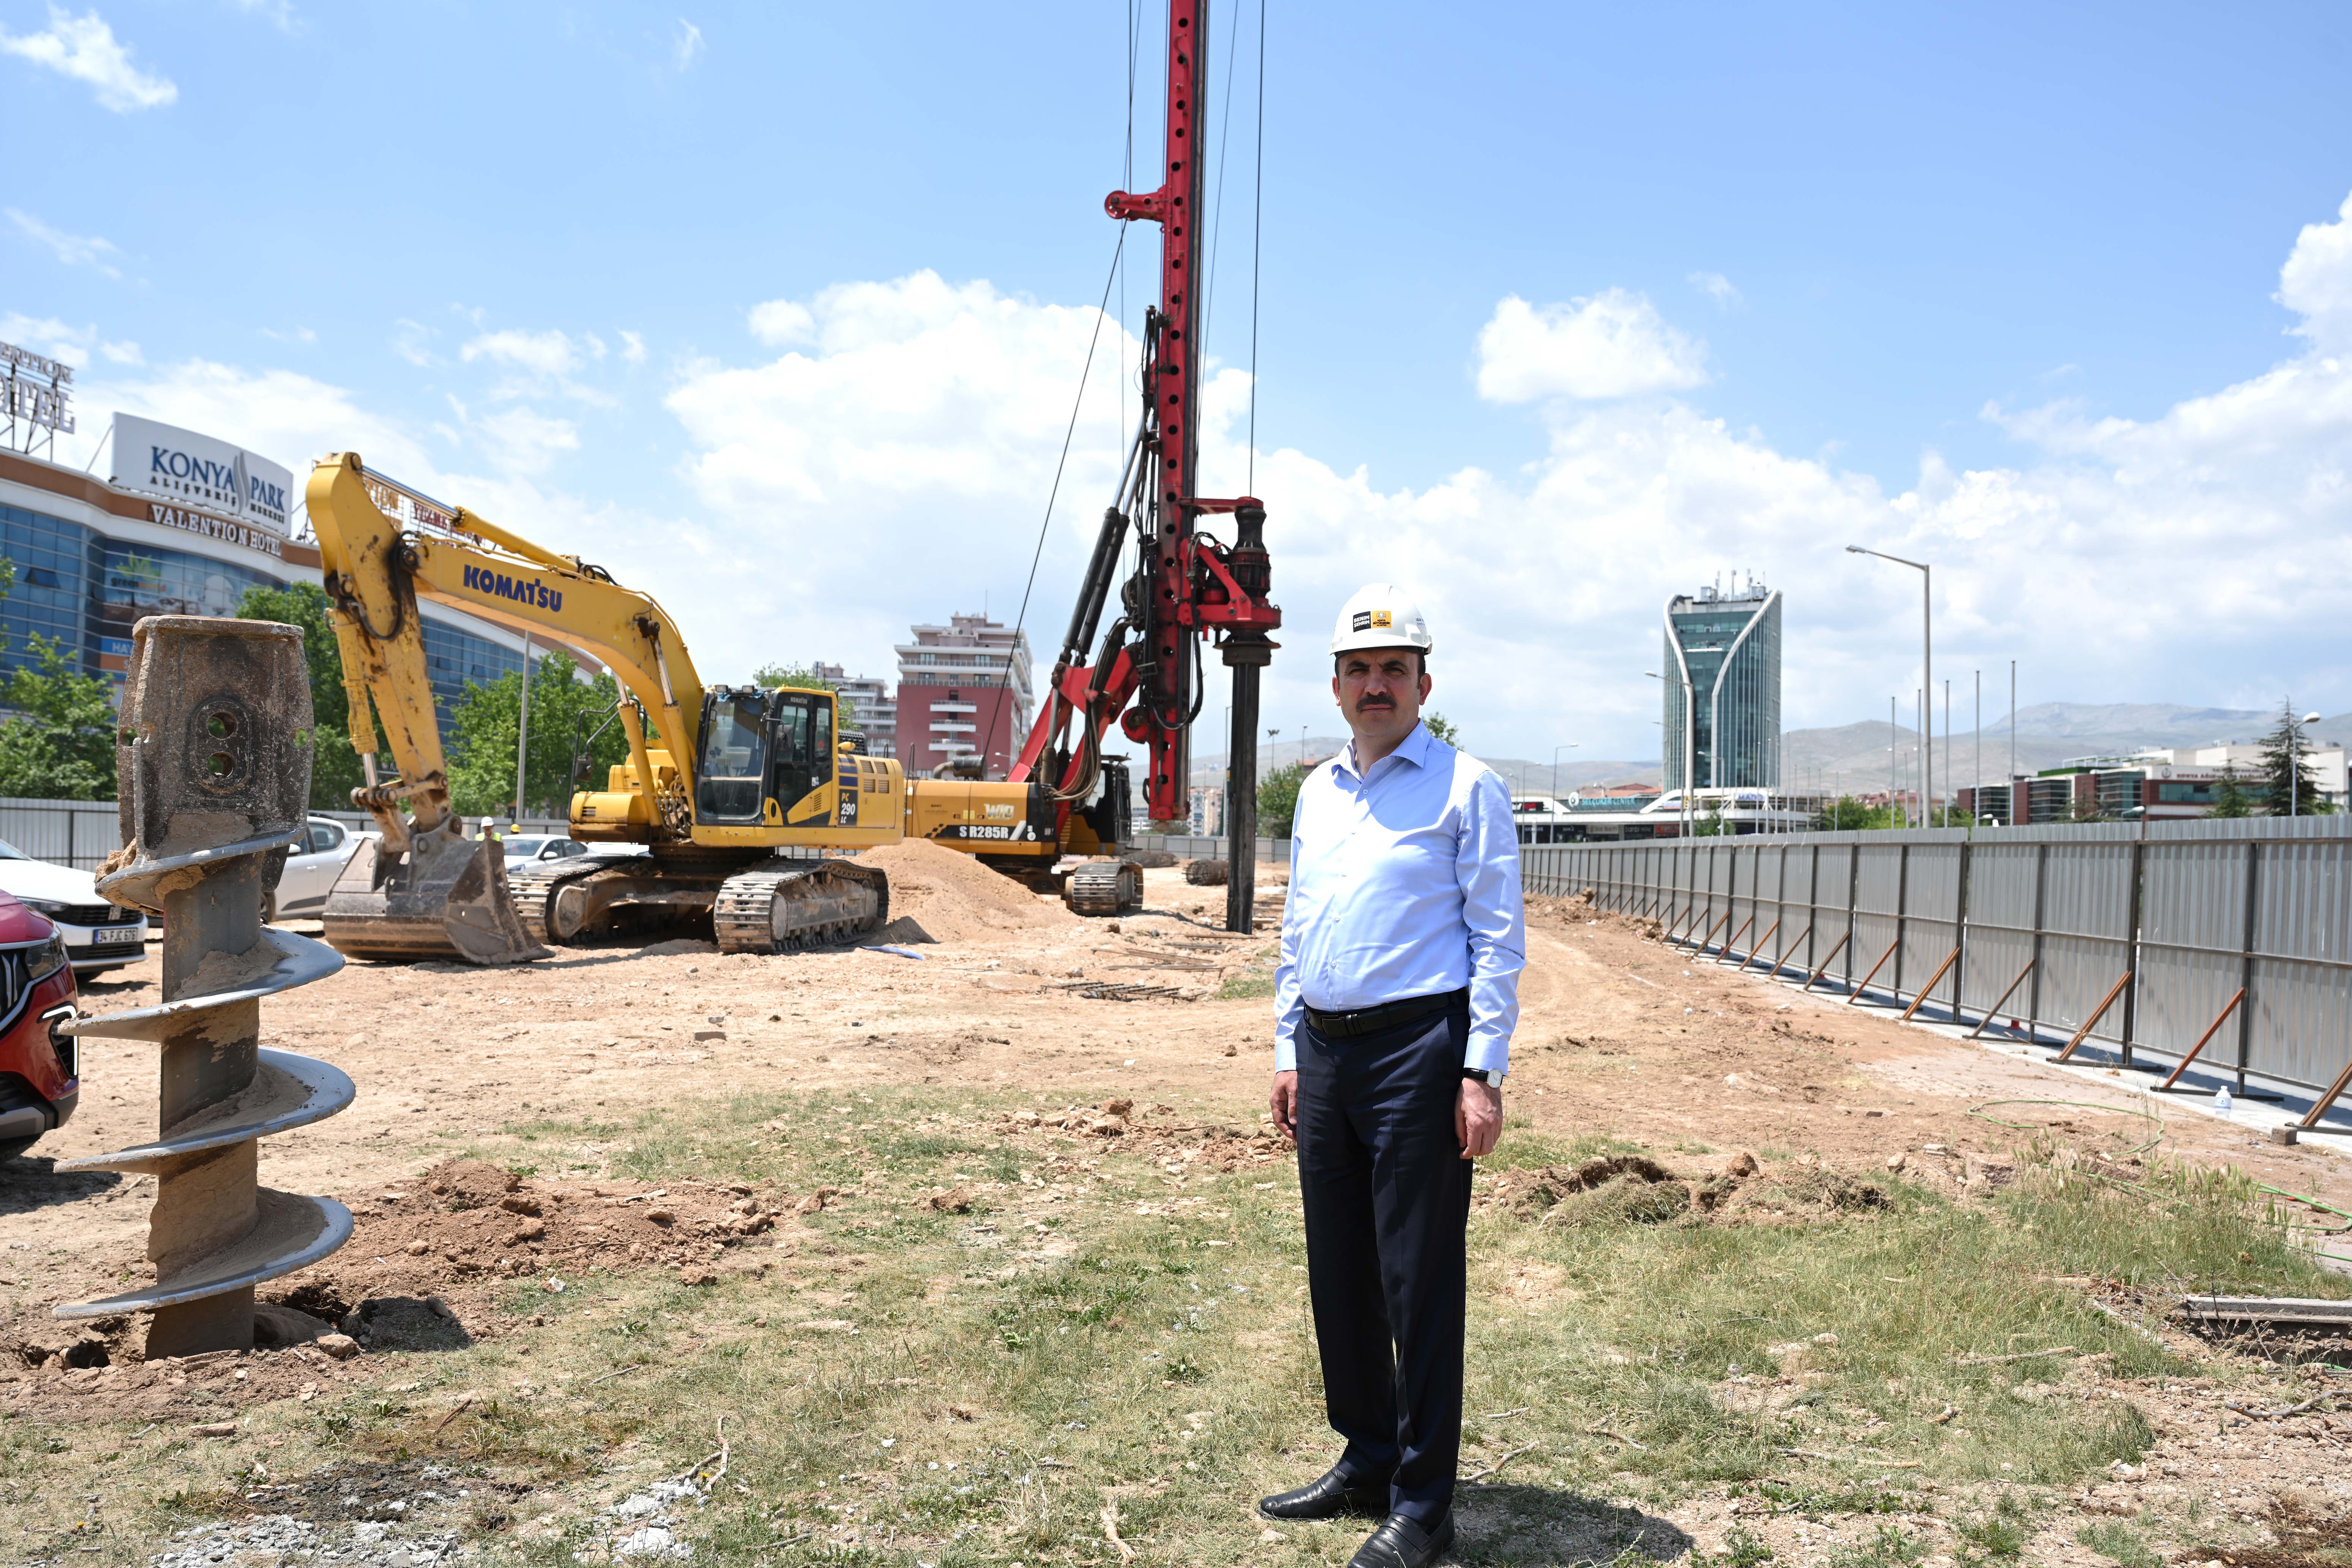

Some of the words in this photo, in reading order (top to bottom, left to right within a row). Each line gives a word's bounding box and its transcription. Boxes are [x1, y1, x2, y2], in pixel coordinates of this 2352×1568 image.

[151, 446, 237, 493] KONYA
[251, 476, 285, 512] PARK
[152, 505, 247, 545] VALENTION
[250, 530, 282, 556] HOTEL
[463, 564, 562, 612] KOMATSU
[841, 803, 855, 815] 290
[842, 793, 849, 801] PC
[99, 931, 107, 942] 34
